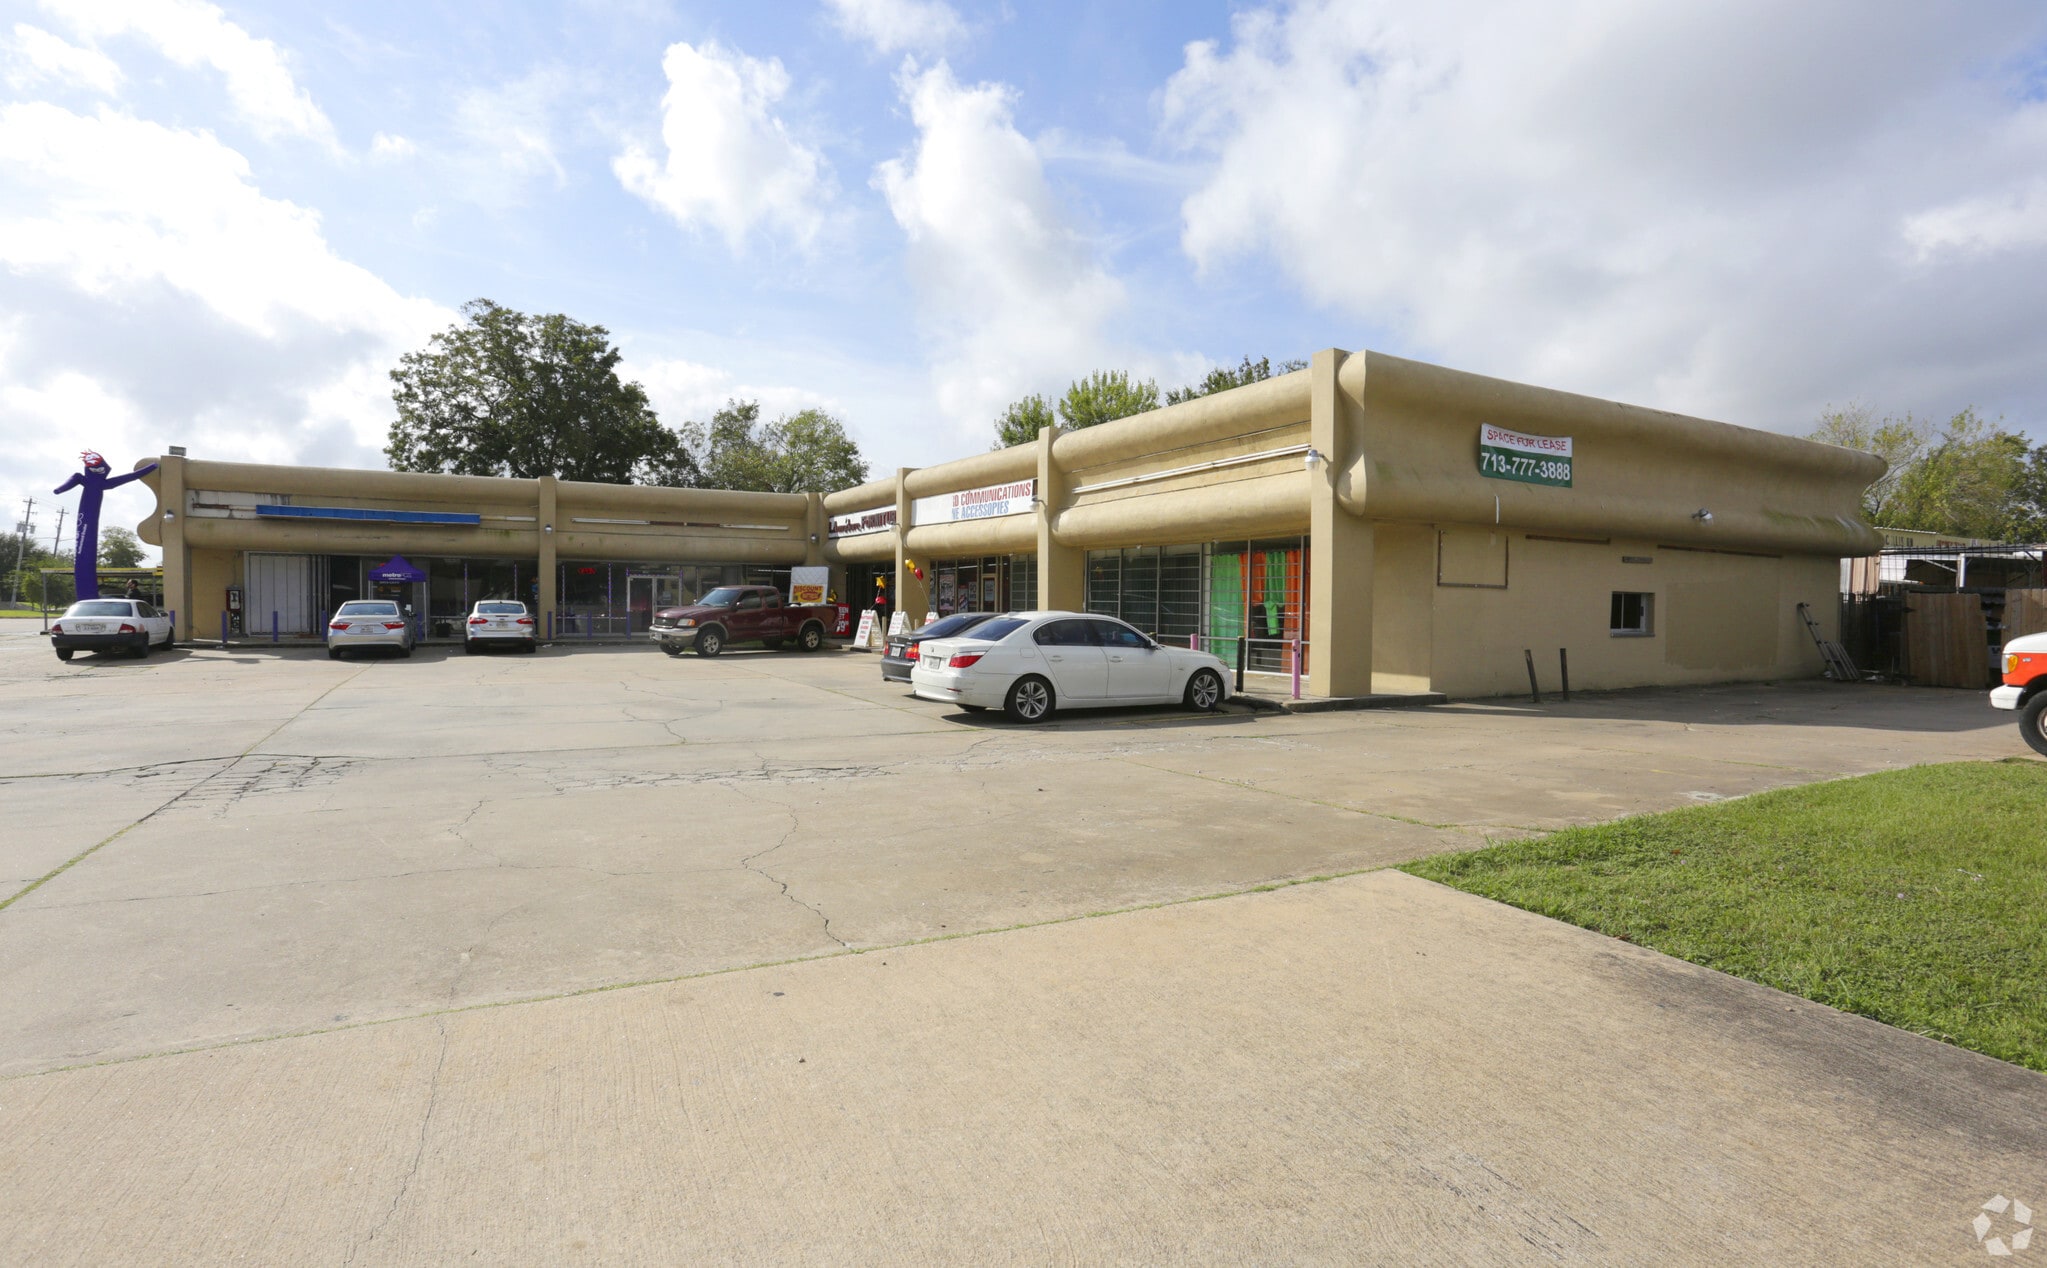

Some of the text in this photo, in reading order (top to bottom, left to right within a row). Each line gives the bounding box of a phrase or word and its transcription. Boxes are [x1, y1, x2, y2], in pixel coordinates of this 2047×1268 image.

[1487, 429, 1566, 451] SPACE FOR LEASE
[1481, 452, 1570, 480] 713-777-3888
[961, 482, 1031, 506] COMMUNICATIONS
